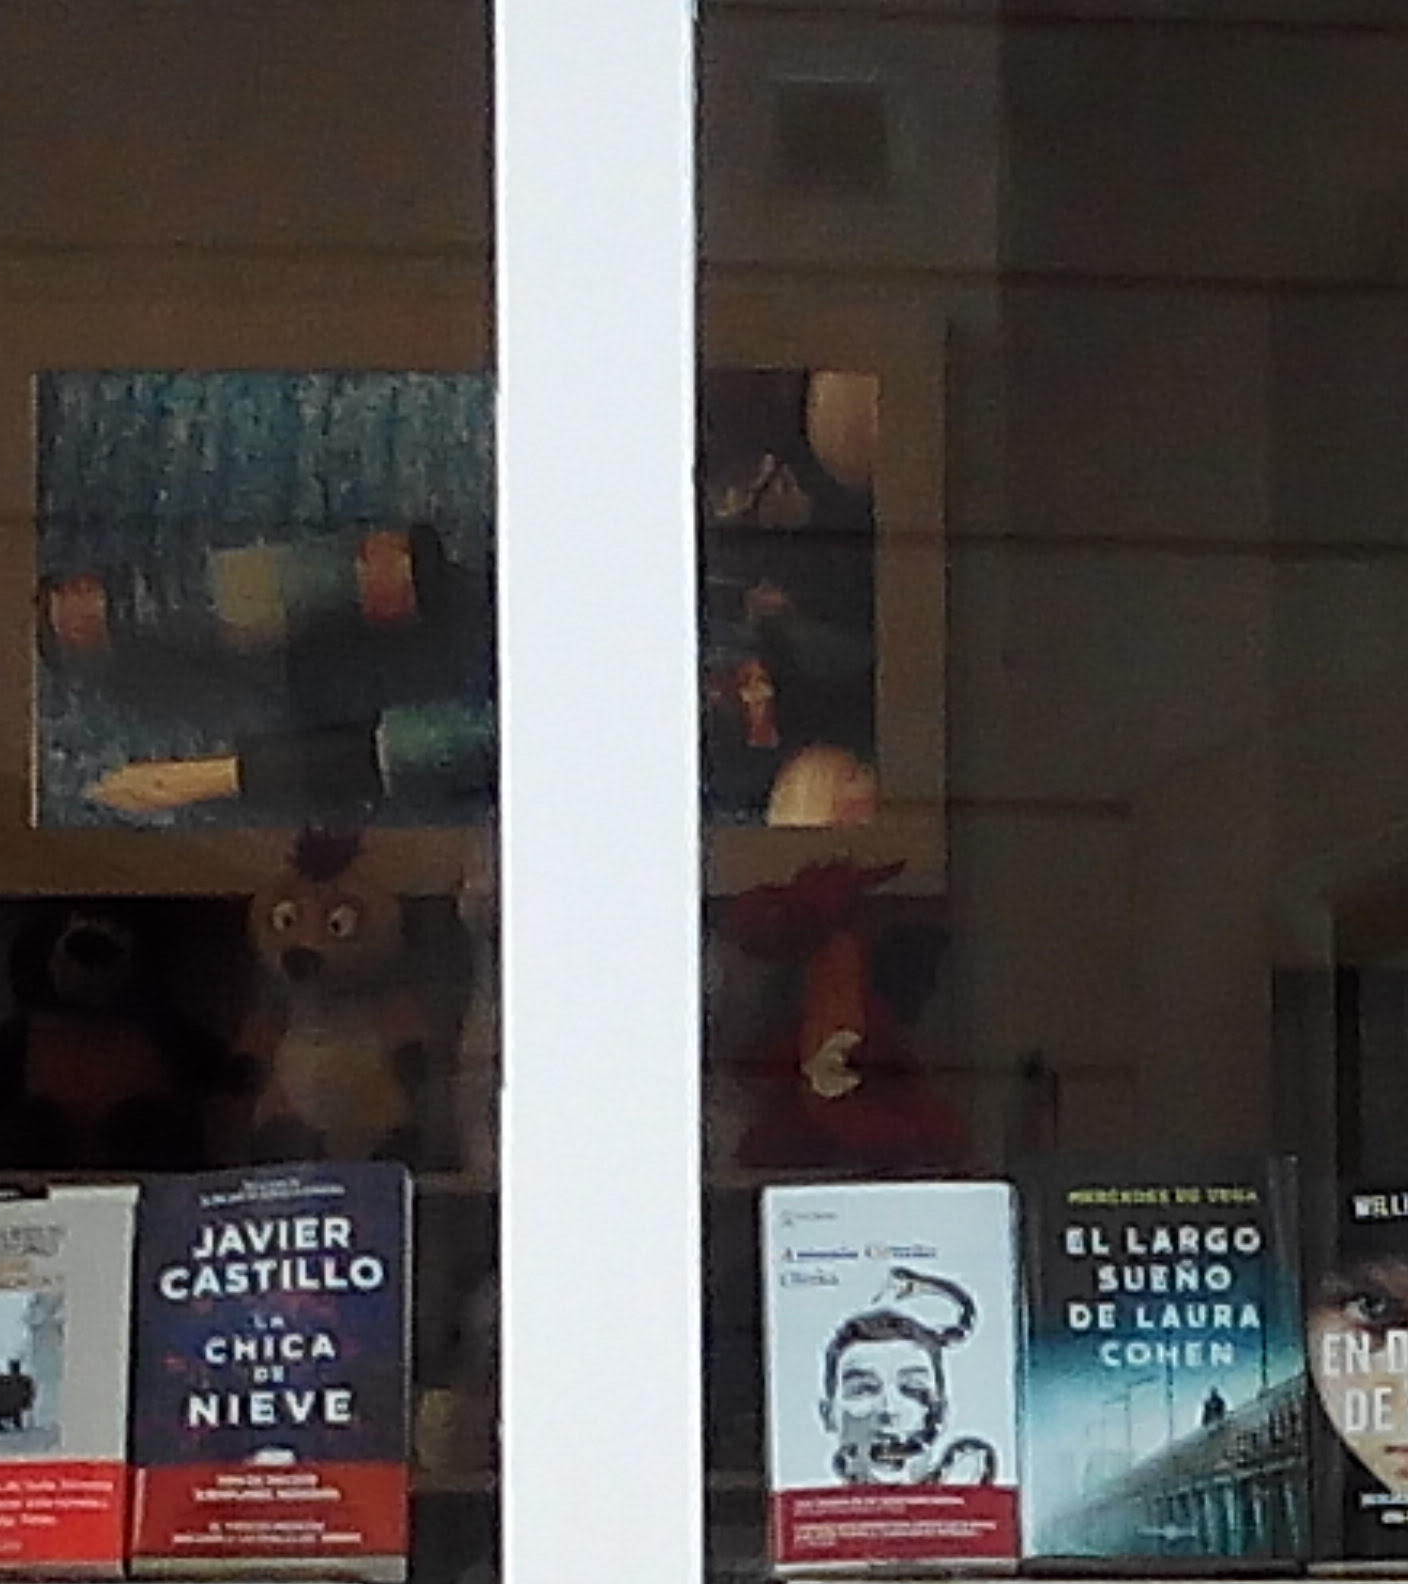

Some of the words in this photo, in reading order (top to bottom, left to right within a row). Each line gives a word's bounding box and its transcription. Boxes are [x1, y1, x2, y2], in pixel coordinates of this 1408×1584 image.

[192, 1215, 352, 1260] JAVIER
[1065, 1225, 1111, 1256] EL
[1125, 1224, 1262, 1255] LARGO
[158, 1254, 385, 1301] CASTILLO
[1097, 1258, 1233, 1293] SUEÑO
[1067, 1302, 1117, 1330] DE
[1135, 1303, 1262, 1329] LAURA
[204, 1331, 337, 1366] CHICA
[1100, 1340, 1234, 1368] COHEN
[1321, 1331, 1372, 1378] EN
[188, 1388, 353, 1429] NIEVE
[1344, 1384, 1393, 1433] DE
